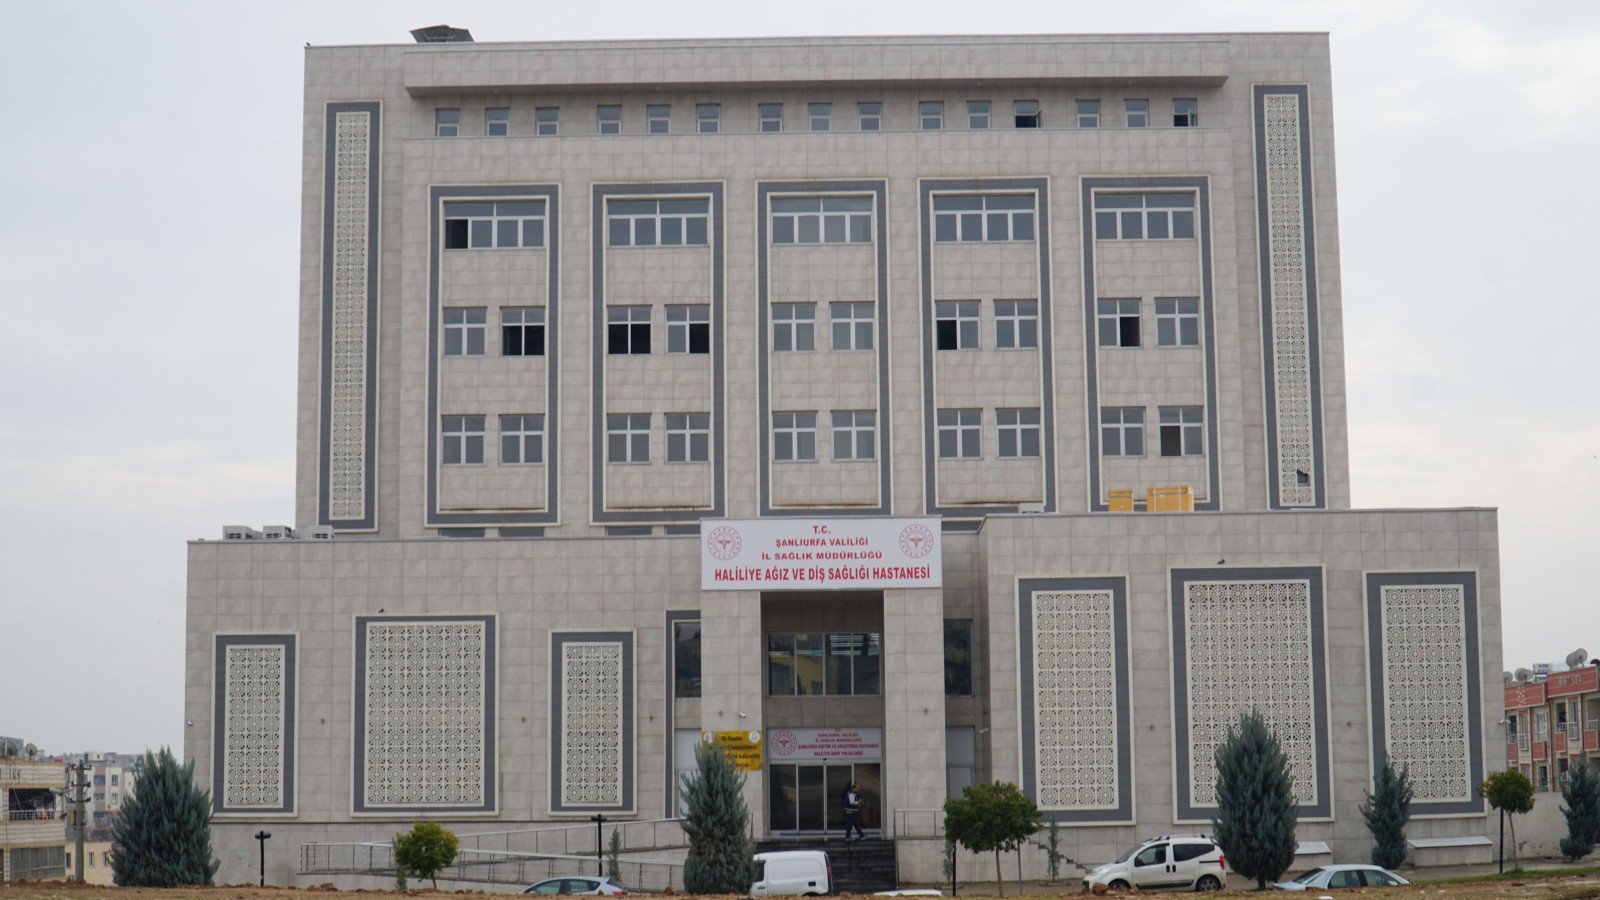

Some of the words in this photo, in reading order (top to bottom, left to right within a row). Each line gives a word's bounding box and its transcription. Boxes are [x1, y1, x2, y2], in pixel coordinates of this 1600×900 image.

[812, 525, 832, 534] T.C.
[776, 539, 827, 548] ŞANLIURFA
[829, 537, 869, 546] VALİLİĞİ
[761, 552, 772, 560] İL
[774, 551, 813, 560] SAĞLIK
[816, 551, 883, 560] MÜDÜRLÜĞÜ
[714, 566, 762, 581] HALİLİYE
[764, 566, 789, 581] AĞIZ
[792, 568, 805, 580] VE
[808, 565, 825, 583] DİŞ
[828, 565, 870, 580] SAĞLIĞI
[872, 564, 931, 580] HASTANESİ
